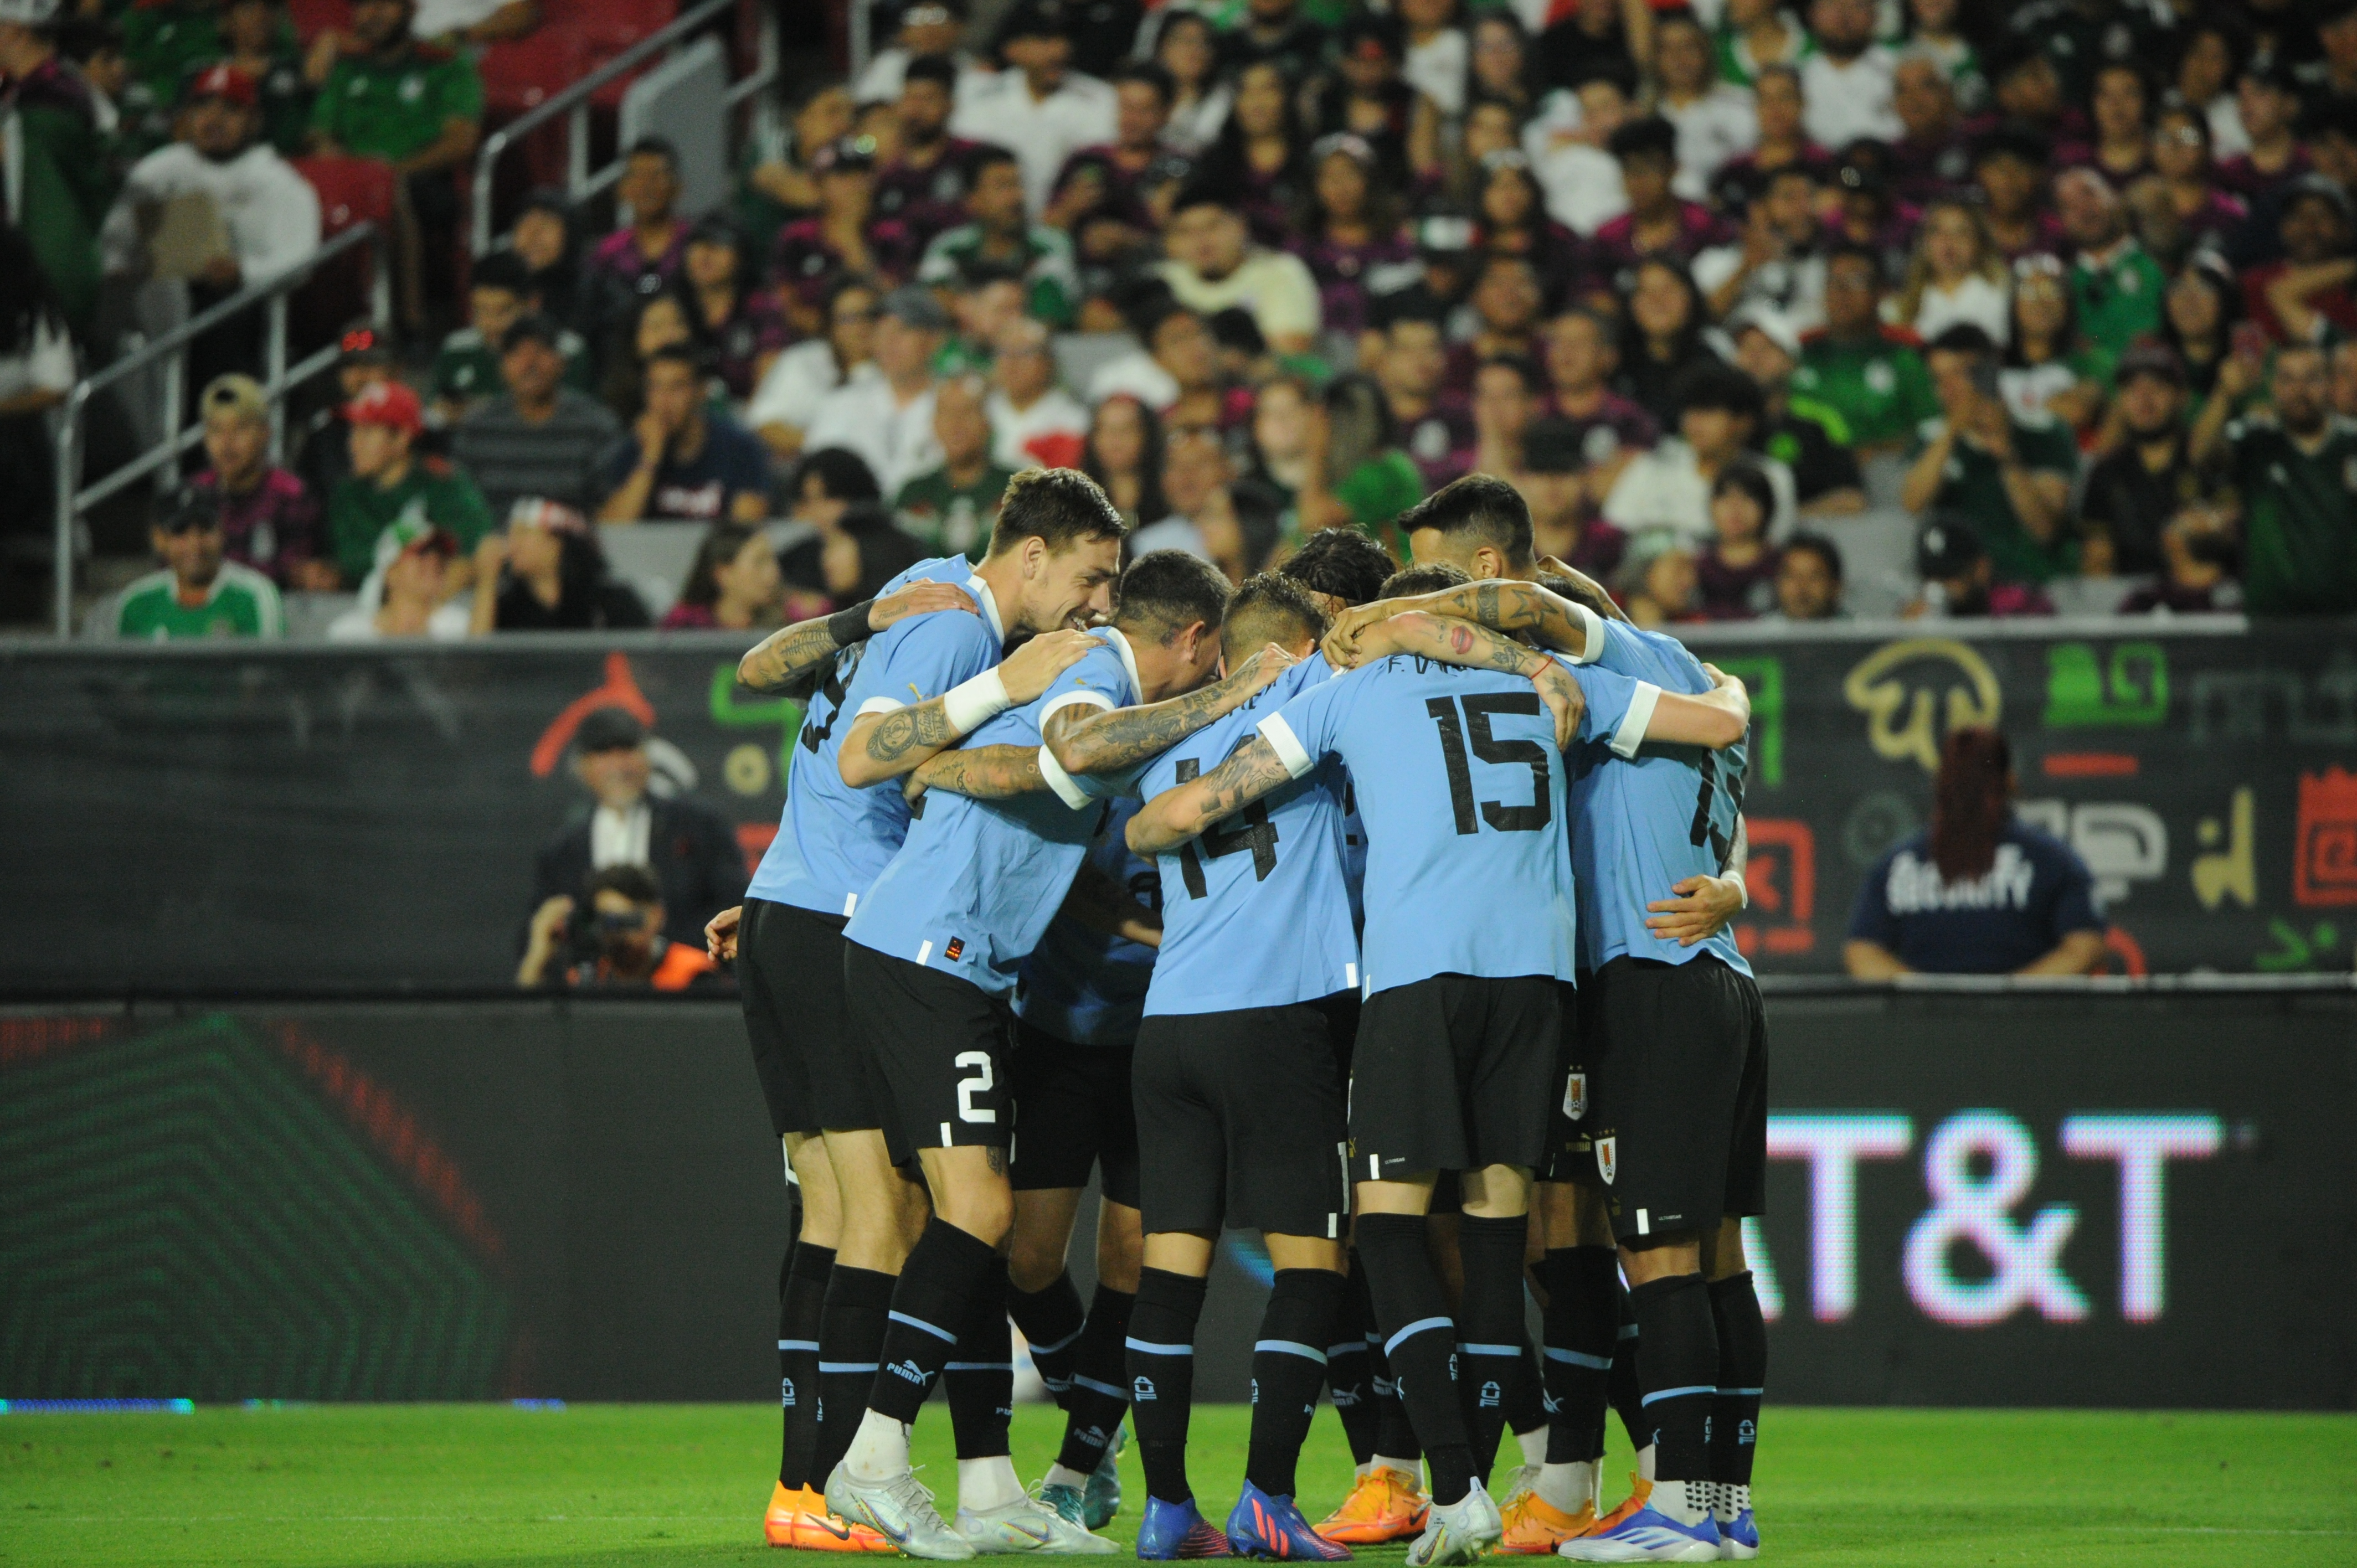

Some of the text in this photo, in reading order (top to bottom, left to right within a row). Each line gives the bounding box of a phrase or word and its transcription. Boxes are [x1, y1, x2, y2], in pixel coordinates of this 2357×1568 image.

[1425, 690, 1552, 835] 15
[1175, 732, 1279, 900] 14
[955, 1051, 996, 1123] 2
[1742, 1108, 2226, 1327] T&T
[887, 1361, 921, 1384] PUMA
[782, 1377, 796, 1408] AUF
[1134, 1375, 1157, 1402] AUF
[1479, 1381, 1501, 1407] AUF
[1738, 1419, 1755, 1445] AUF
